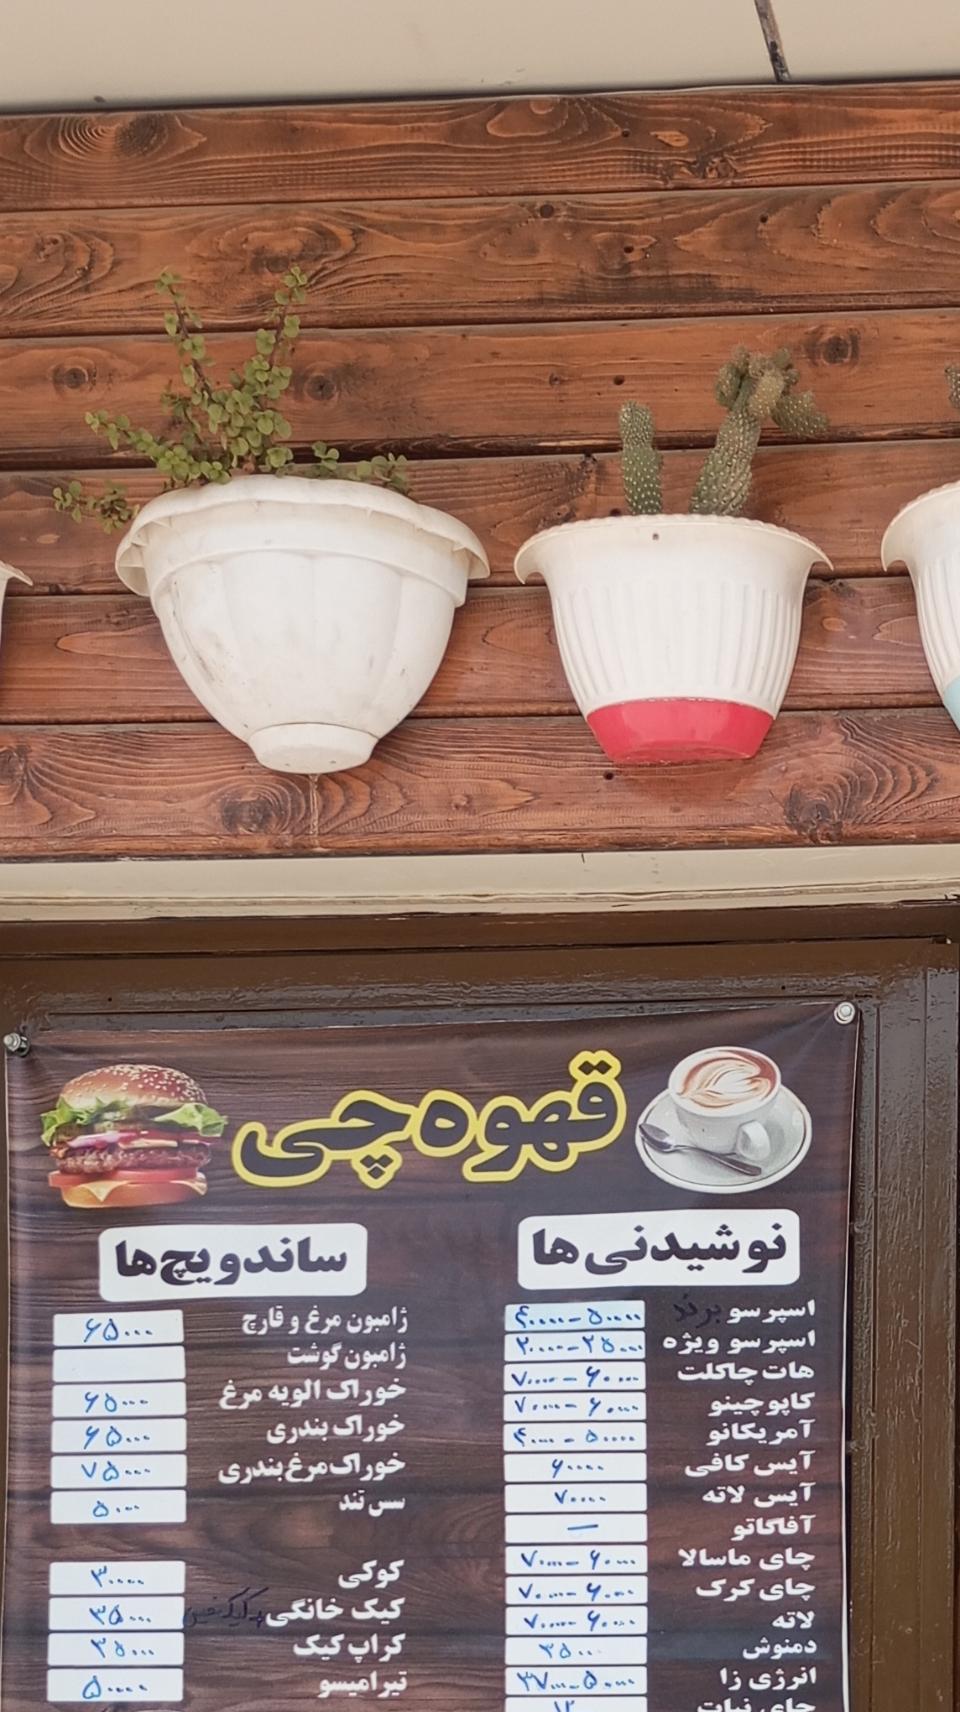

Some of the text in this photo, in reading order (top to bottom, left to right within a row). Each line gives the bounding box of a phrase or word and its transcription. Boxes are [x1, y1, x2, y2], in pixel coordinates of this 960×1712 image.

[242, 1305, 408, 1335] ژامبون مرغ و قارچ
[727, 1299, 816, 1323] اسپرسو
[663, 1329, 816, 1355] اسپرسو ویژه
[287, 1342, 406, 1370] ژامبون گوشت
[677, 1361, 815, 1386] هات چاکلت
[219, 1378, 406, 1409] خوراک الویه مرغ
[708, 1392, 816, 1417] کاپوچینو
[267, 1414, 405, 1443] خوراک بندری
[706, 1419, 816, 1446] آمریکانو
[685, 1450, 816, 1477] آیس کافی
[339, 1490, 405, 1516] سس تند
[702, 1482, 817, 1508] آیس لاته
[678, 1547, 816, 1571] چای ماسالا
[338, 1559, 404, 1588] کوکی
[695, 1578, 816, 1602] چای کرک
[266, 1597, 405, 1626] کیک خانگی
[772, 1610, 815, 1629] لاته
[293, 1634, 406, 1663] کراپ کیک
[742, 1637, 817, 1660] دمنوش
[317, 1671, 407, 1698] تیرامیسو
[719, 1666, 817, 1691] انرژی زا
